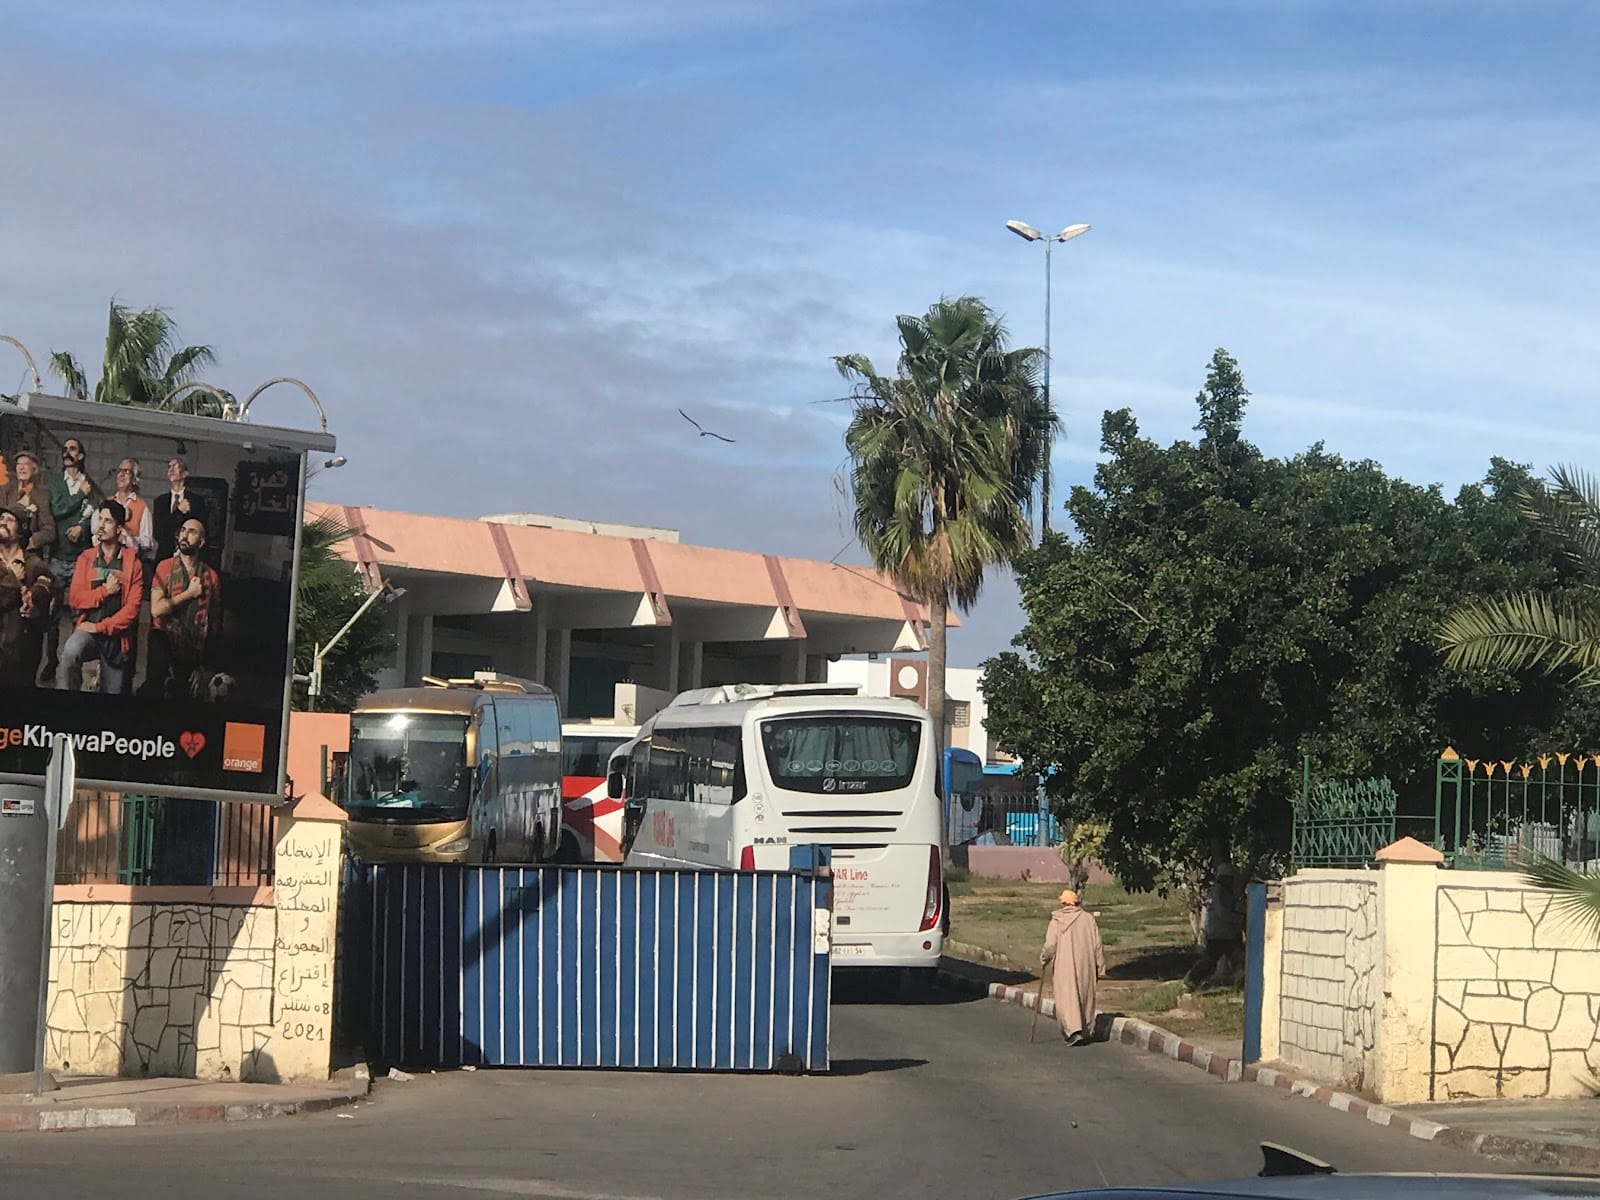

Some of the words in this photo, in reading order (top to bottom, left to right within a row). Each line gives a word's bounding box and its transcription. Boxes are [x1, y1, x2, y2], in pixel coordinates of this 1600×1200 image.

[224, 757, 259, 770] orange
[850, 867, 868, 881] Line
[314, 1002, 330, 1015] 08
[282, 1022, 324, 1041] 2021
